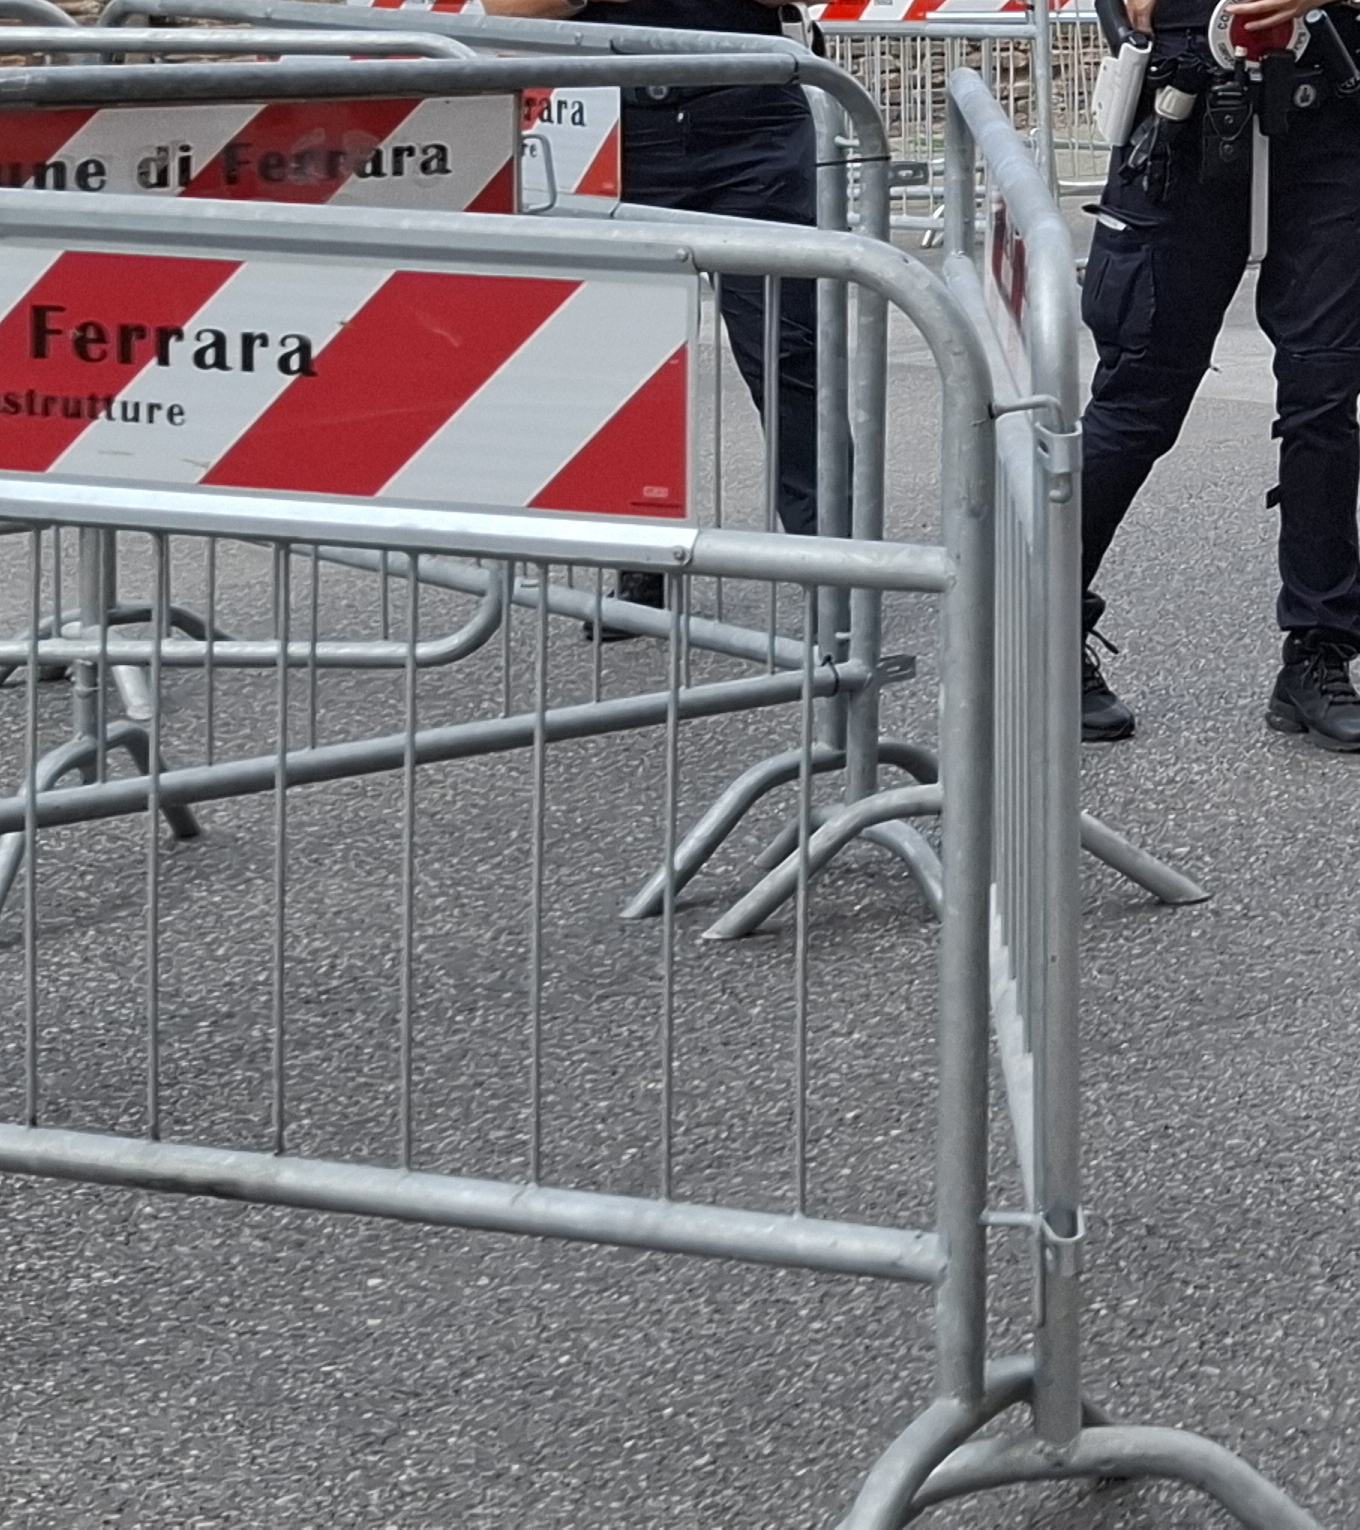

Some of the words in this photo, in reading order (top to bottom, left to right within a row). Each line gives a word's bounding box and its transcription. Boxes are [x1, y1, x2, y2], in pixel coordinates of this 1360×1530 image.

[136, 143, 194, 190] di
[221, 142, 453, 187] Ferrara
[30, 304, 319, 377] Ferrara
[0, 389, 186, 427] strutture
